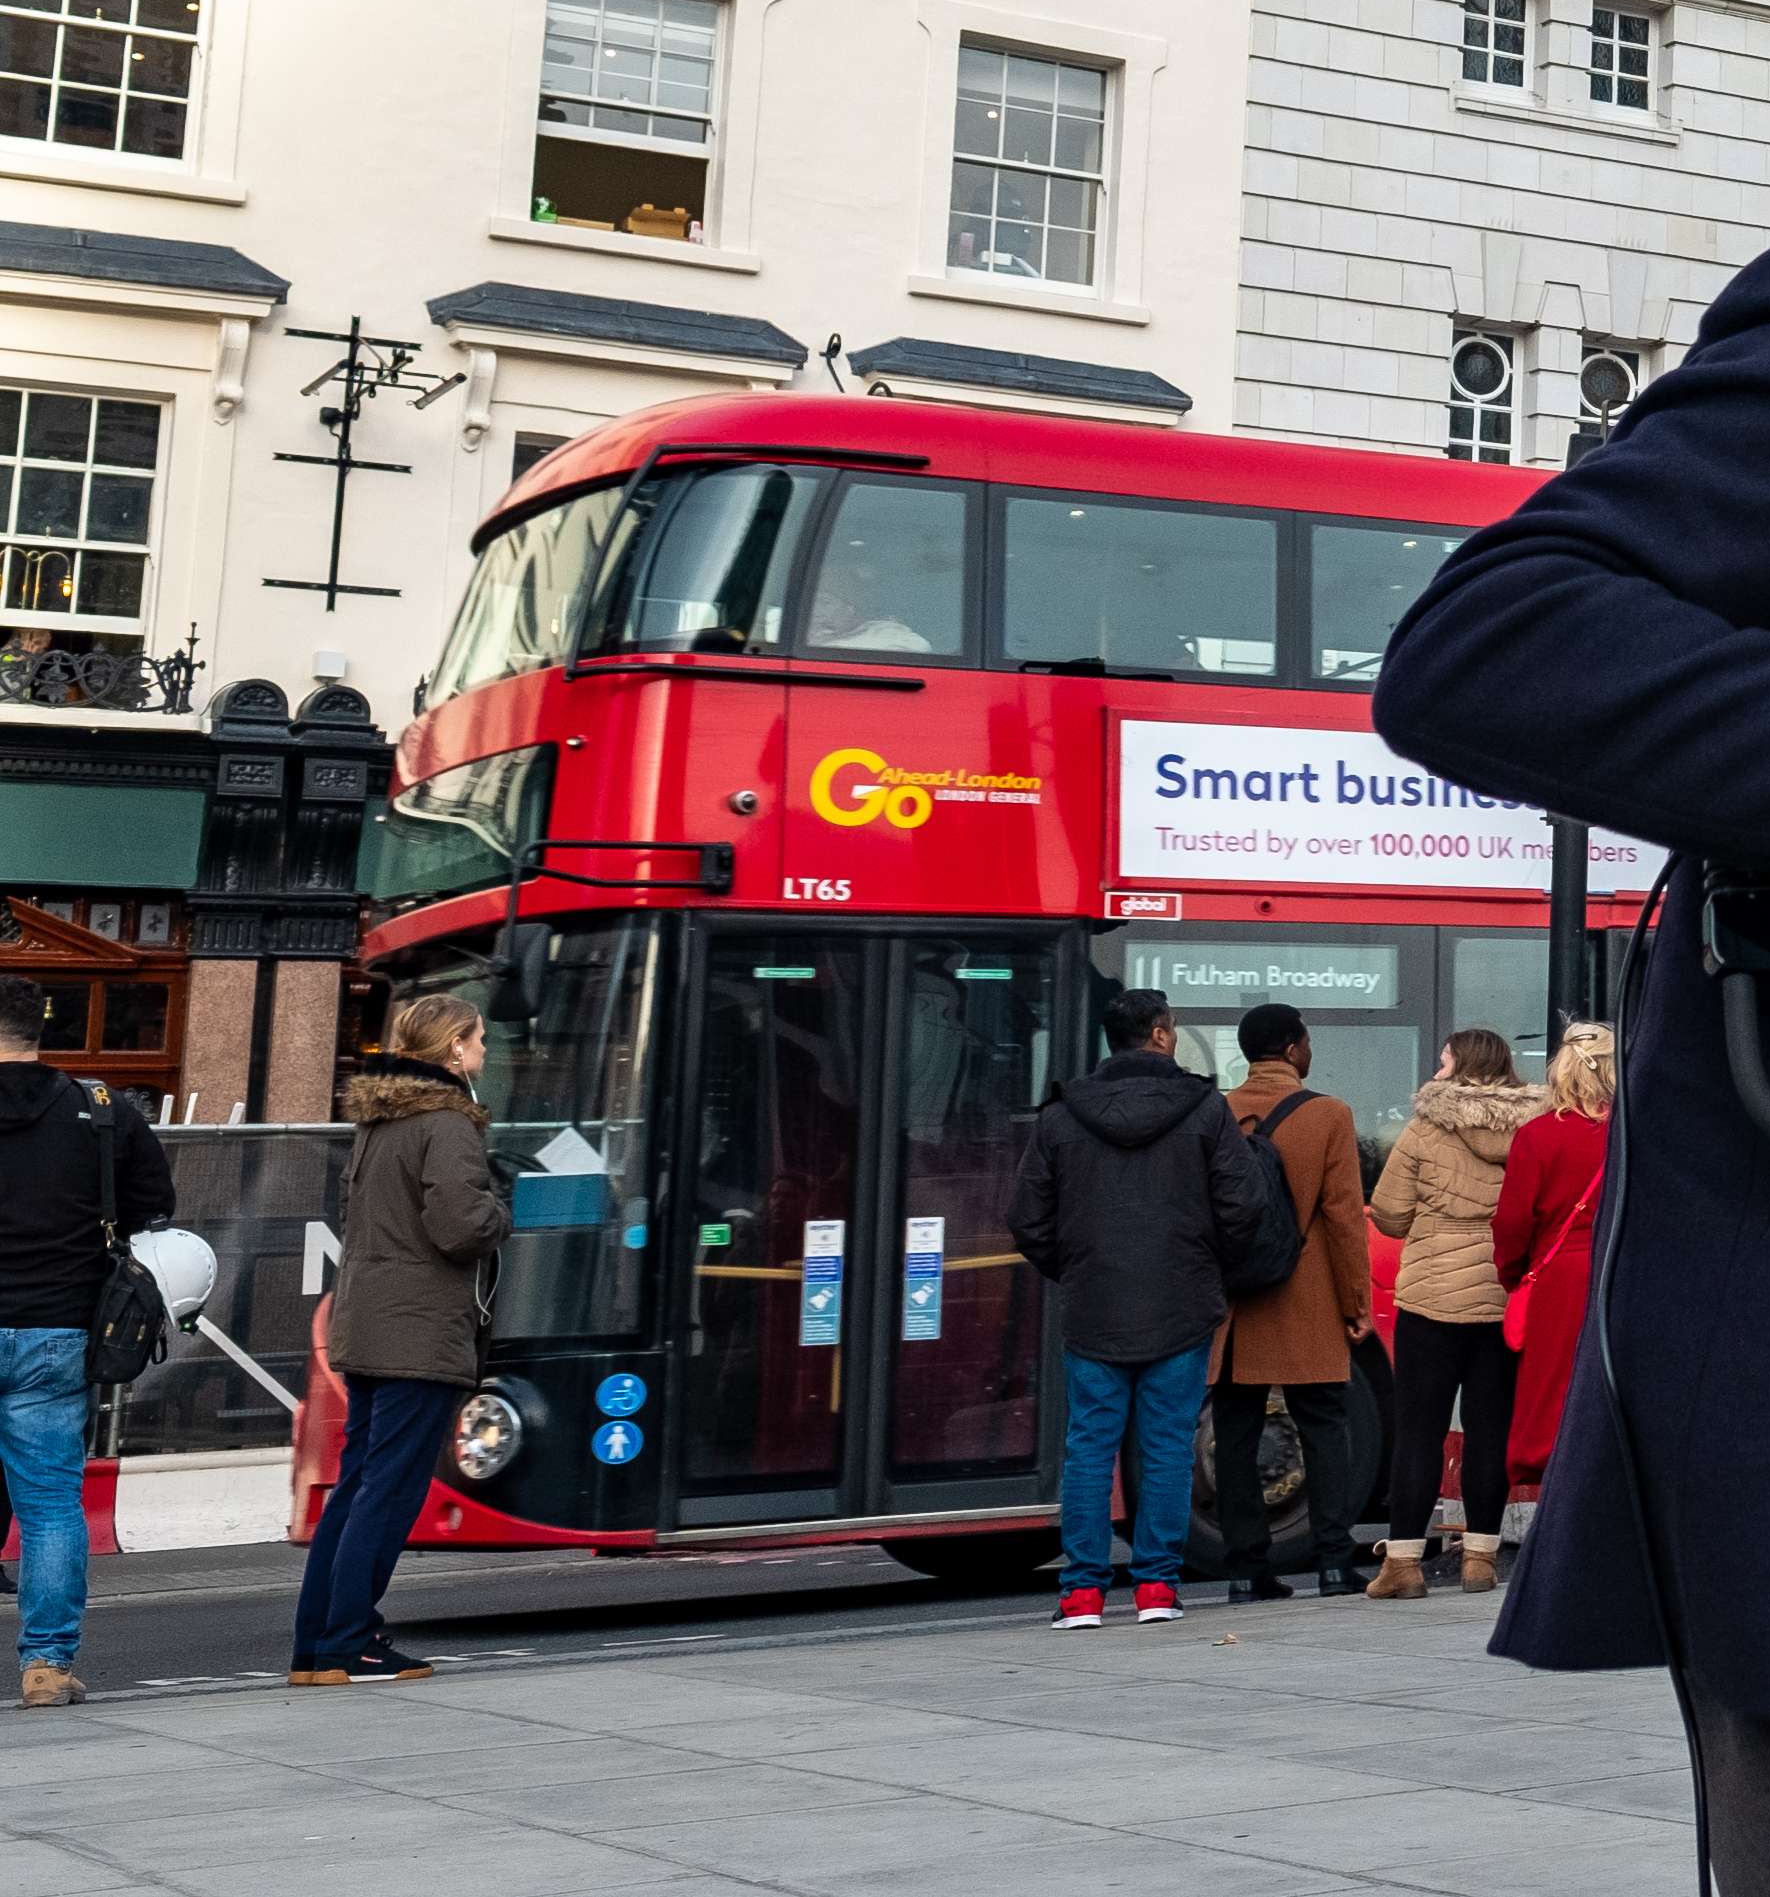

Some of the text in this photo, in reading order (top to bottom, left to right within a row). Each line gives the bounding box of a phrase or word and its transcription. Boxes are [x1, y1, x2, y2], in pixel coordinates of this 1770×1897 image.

[809, 747, 933, 829] Go
[878, 767, 1042, 790] Ahead-London
[1155, 753, 1545, 811] Smart busin
[1154, 826, 1638, 863] Trusted by over 100,000 UK mebers
[783, 877, 852, 901] LT65
[1120, 896, 1167, 915] global
[1171, 962, 1260, 987] Fulham
[1266, 965, 1381, 994] Broadway
